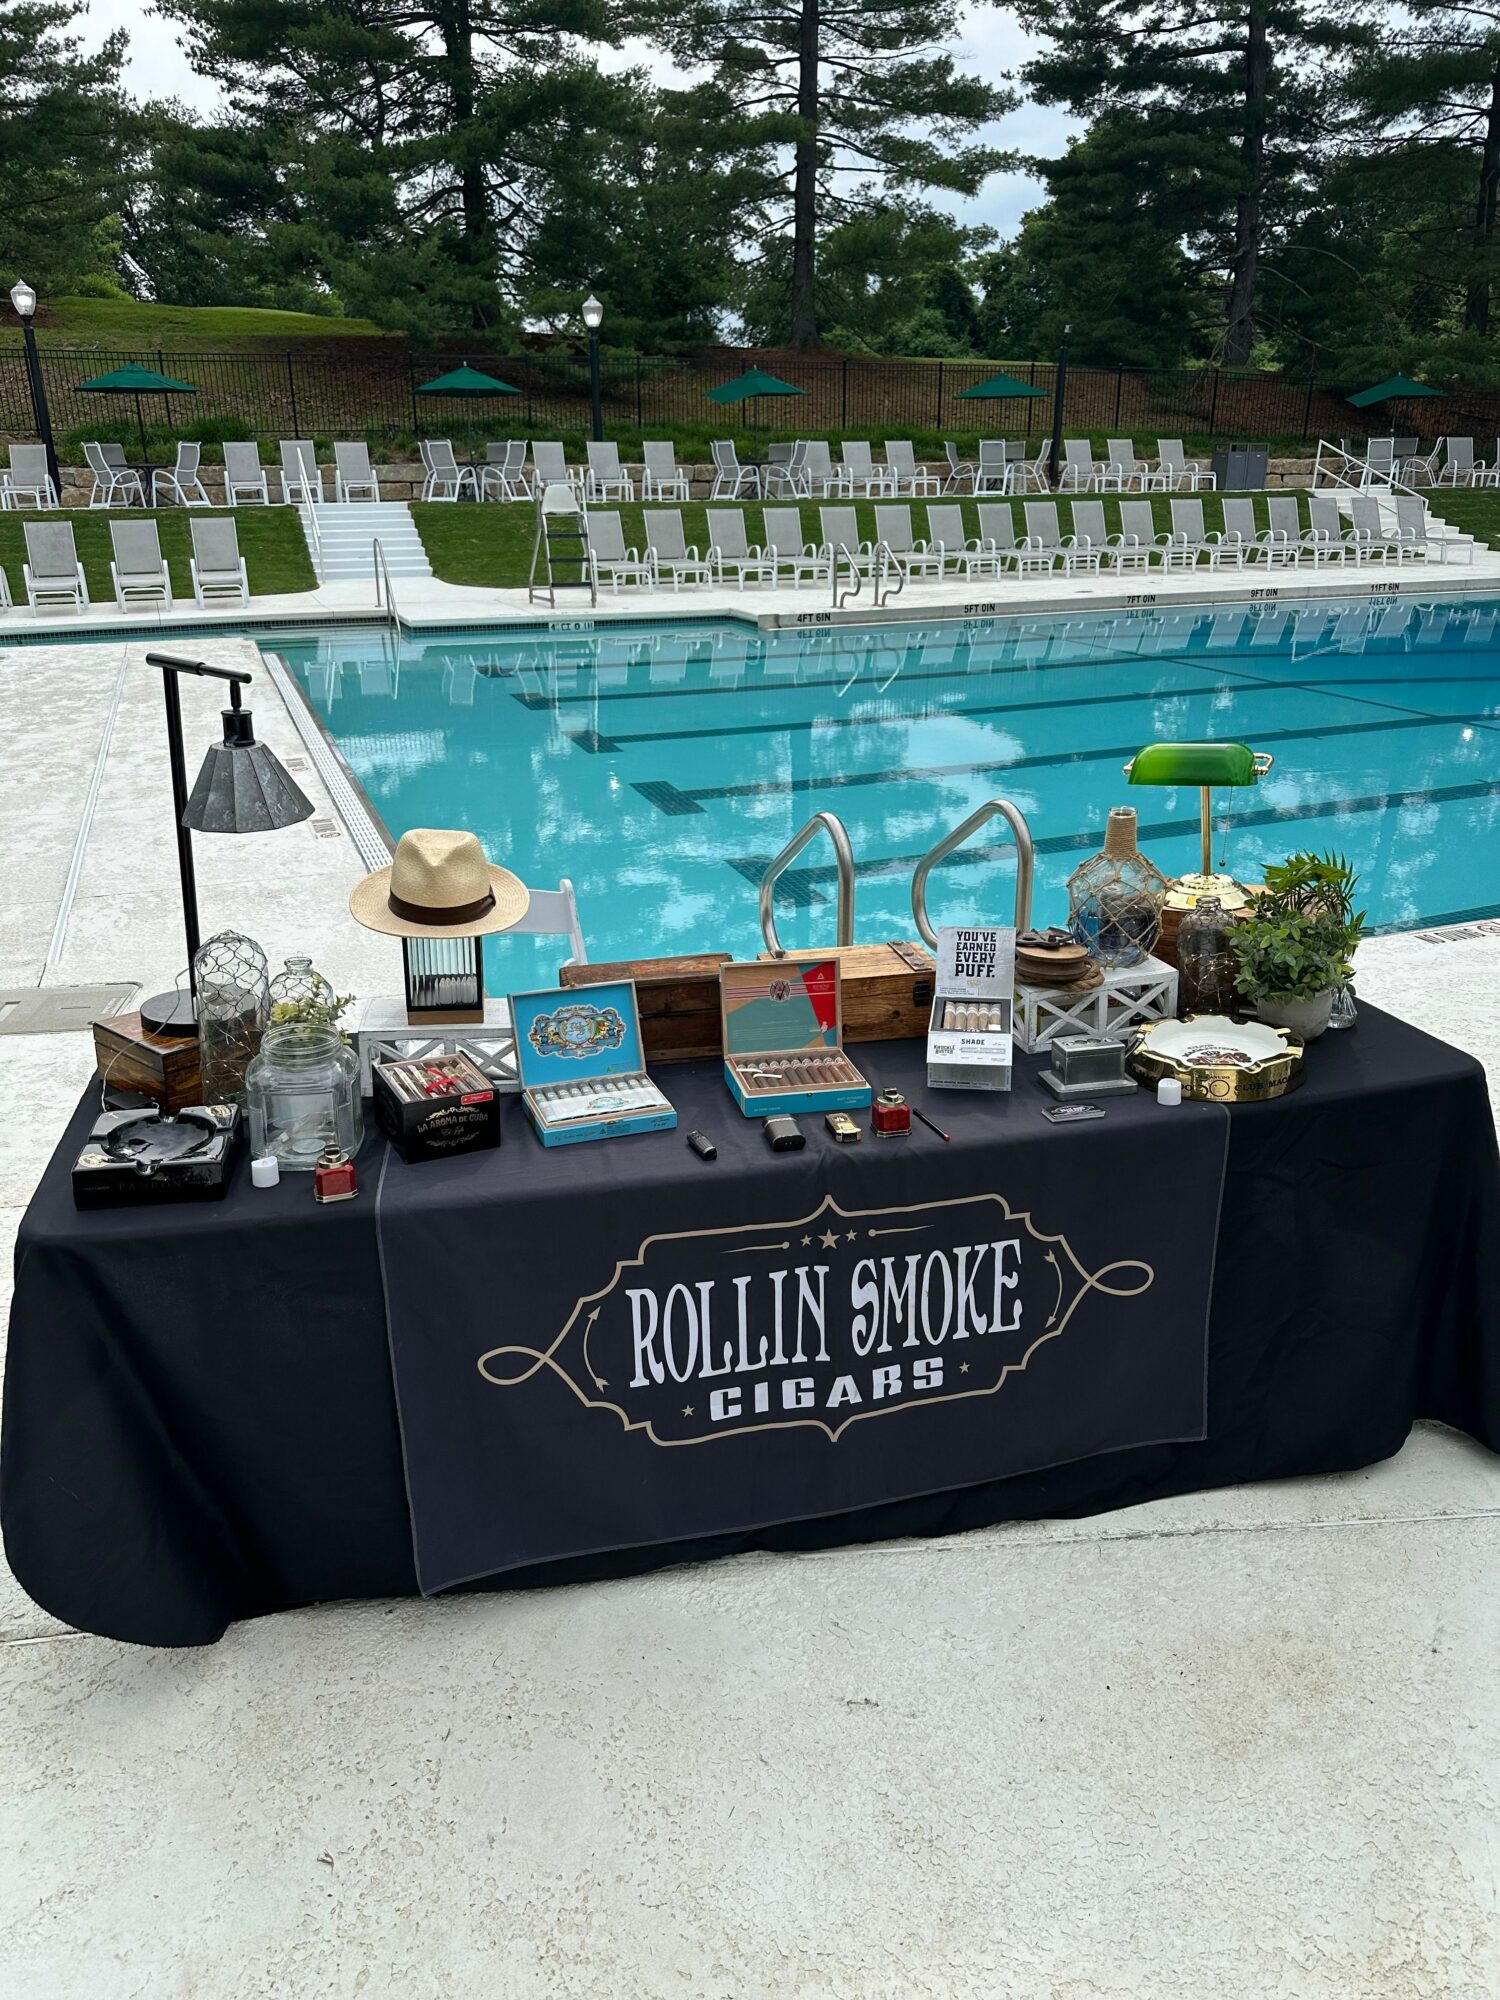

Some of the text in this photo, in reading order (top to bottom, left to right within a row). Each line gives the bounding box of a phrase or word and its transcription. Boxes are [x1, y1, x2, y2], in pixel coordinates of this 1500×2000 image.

[1251, 589, 1264, 598] 9FT
[1127, 595, 1141, 604] 7FT
[964, 604, 980, 613] 5FT
[797, 613, 831, 623] 4FT 6IN
[956, 931, 997, 942] YOU'VE
[956, 942, 996, 952] EARNED
[955, 951, 996, 963] EVERY
[954, 963, 996, 978] PUFF.
[961, 1038, 986, 1046] SHADE
[430, 1115, 458, 1129] AROMA
[469, 1113, 489, 1122] CUBA
[625, 1238, 1023, 1389] ROLLIN SMOKE
[709, 1357, 946, 1422] CIGARS
